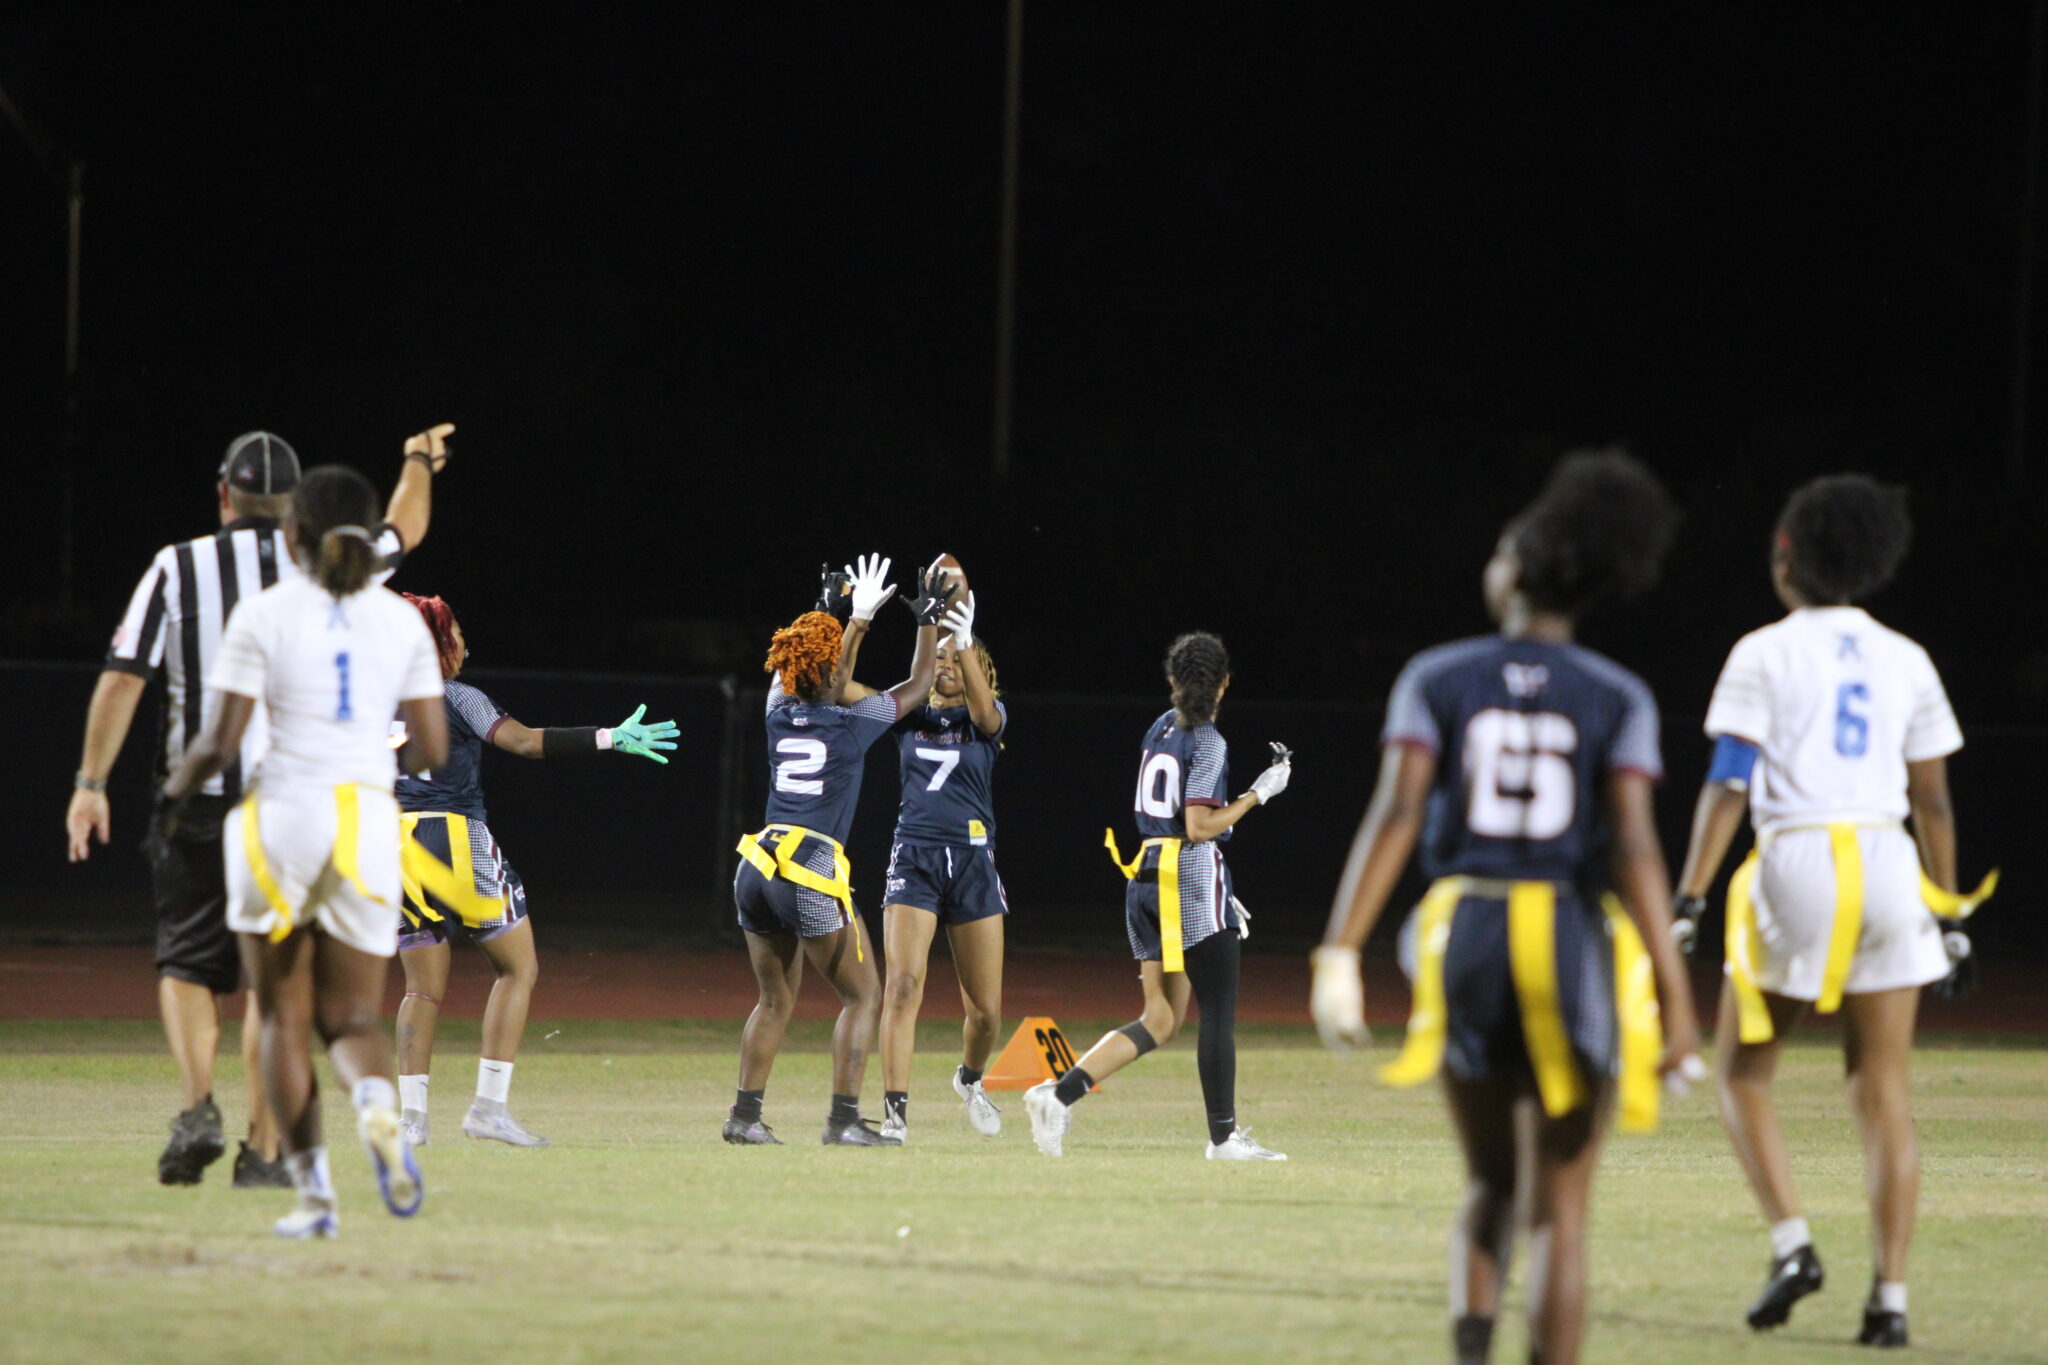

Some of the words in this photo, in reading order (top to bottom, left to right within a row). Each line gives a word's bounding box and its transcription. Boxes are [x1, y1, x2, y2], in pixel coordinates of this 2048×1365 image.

[335, 652, 354, 721] 1
[1834, 682, 1870, 759] 6
[775, 737, 828, 796] 2
[915, 747, 960, 792] 7
[1463, 707, 1577, 840] 6
[1035, 1028, 1076, 1081] 20
